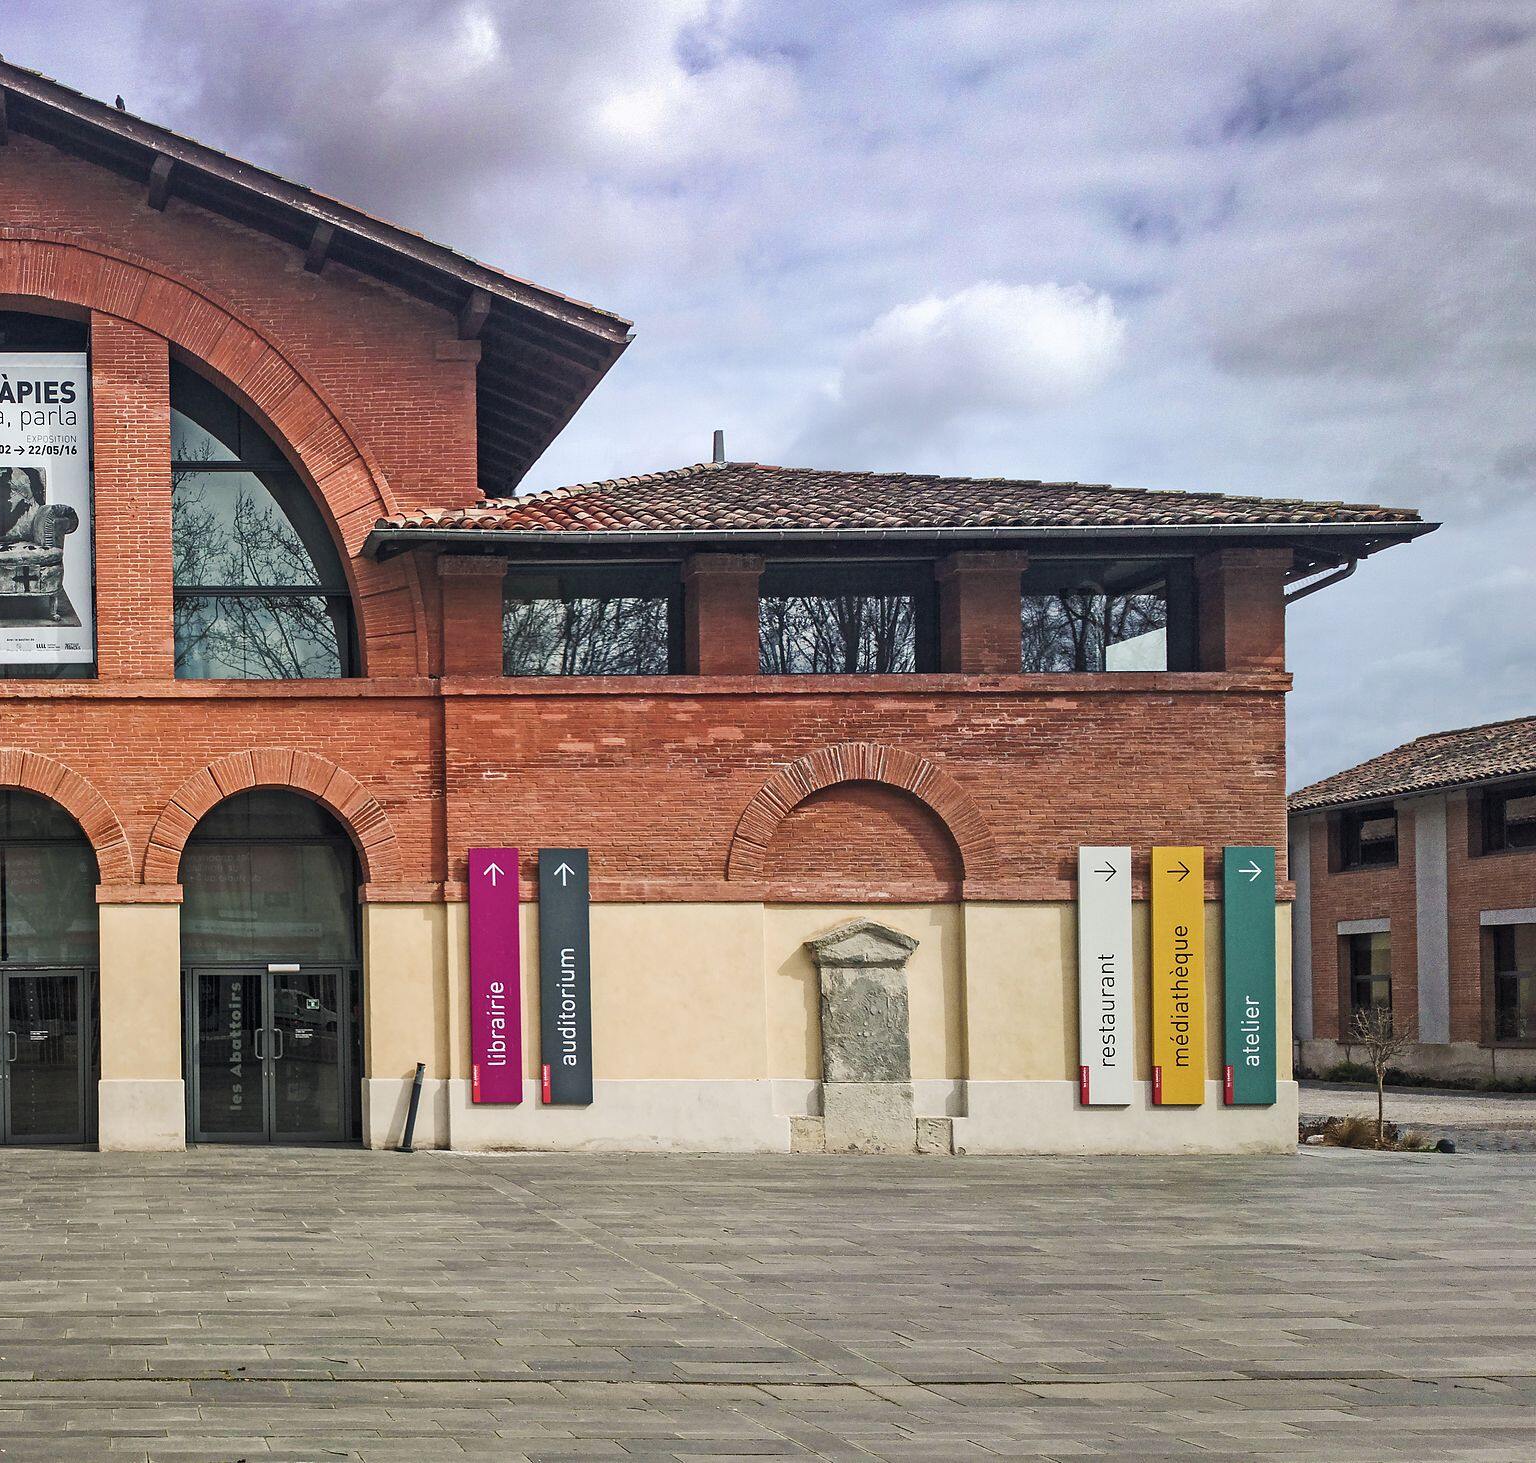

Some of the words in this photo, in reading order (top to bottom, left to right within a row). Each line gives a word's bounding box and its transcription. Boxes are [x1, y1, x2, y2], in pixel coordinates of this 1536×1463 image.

[20, 404, 77, 431] parla
[26, 434, 77, 444] EXPOSITION
[28, 444, 78, 456] 22/05/16
[229, 982, 242, 1078] Abattoirs
[486, 981, 506, 1066] librairie
[555, 947, 577, 1066] auditorium
[1097, 953, 1116, 1067] restaurant
[1169, 925, 1194, 1067] médiathèque
[1240, 995, 1260, 1067] atelier
[229, 1084, 242, 1111] les
